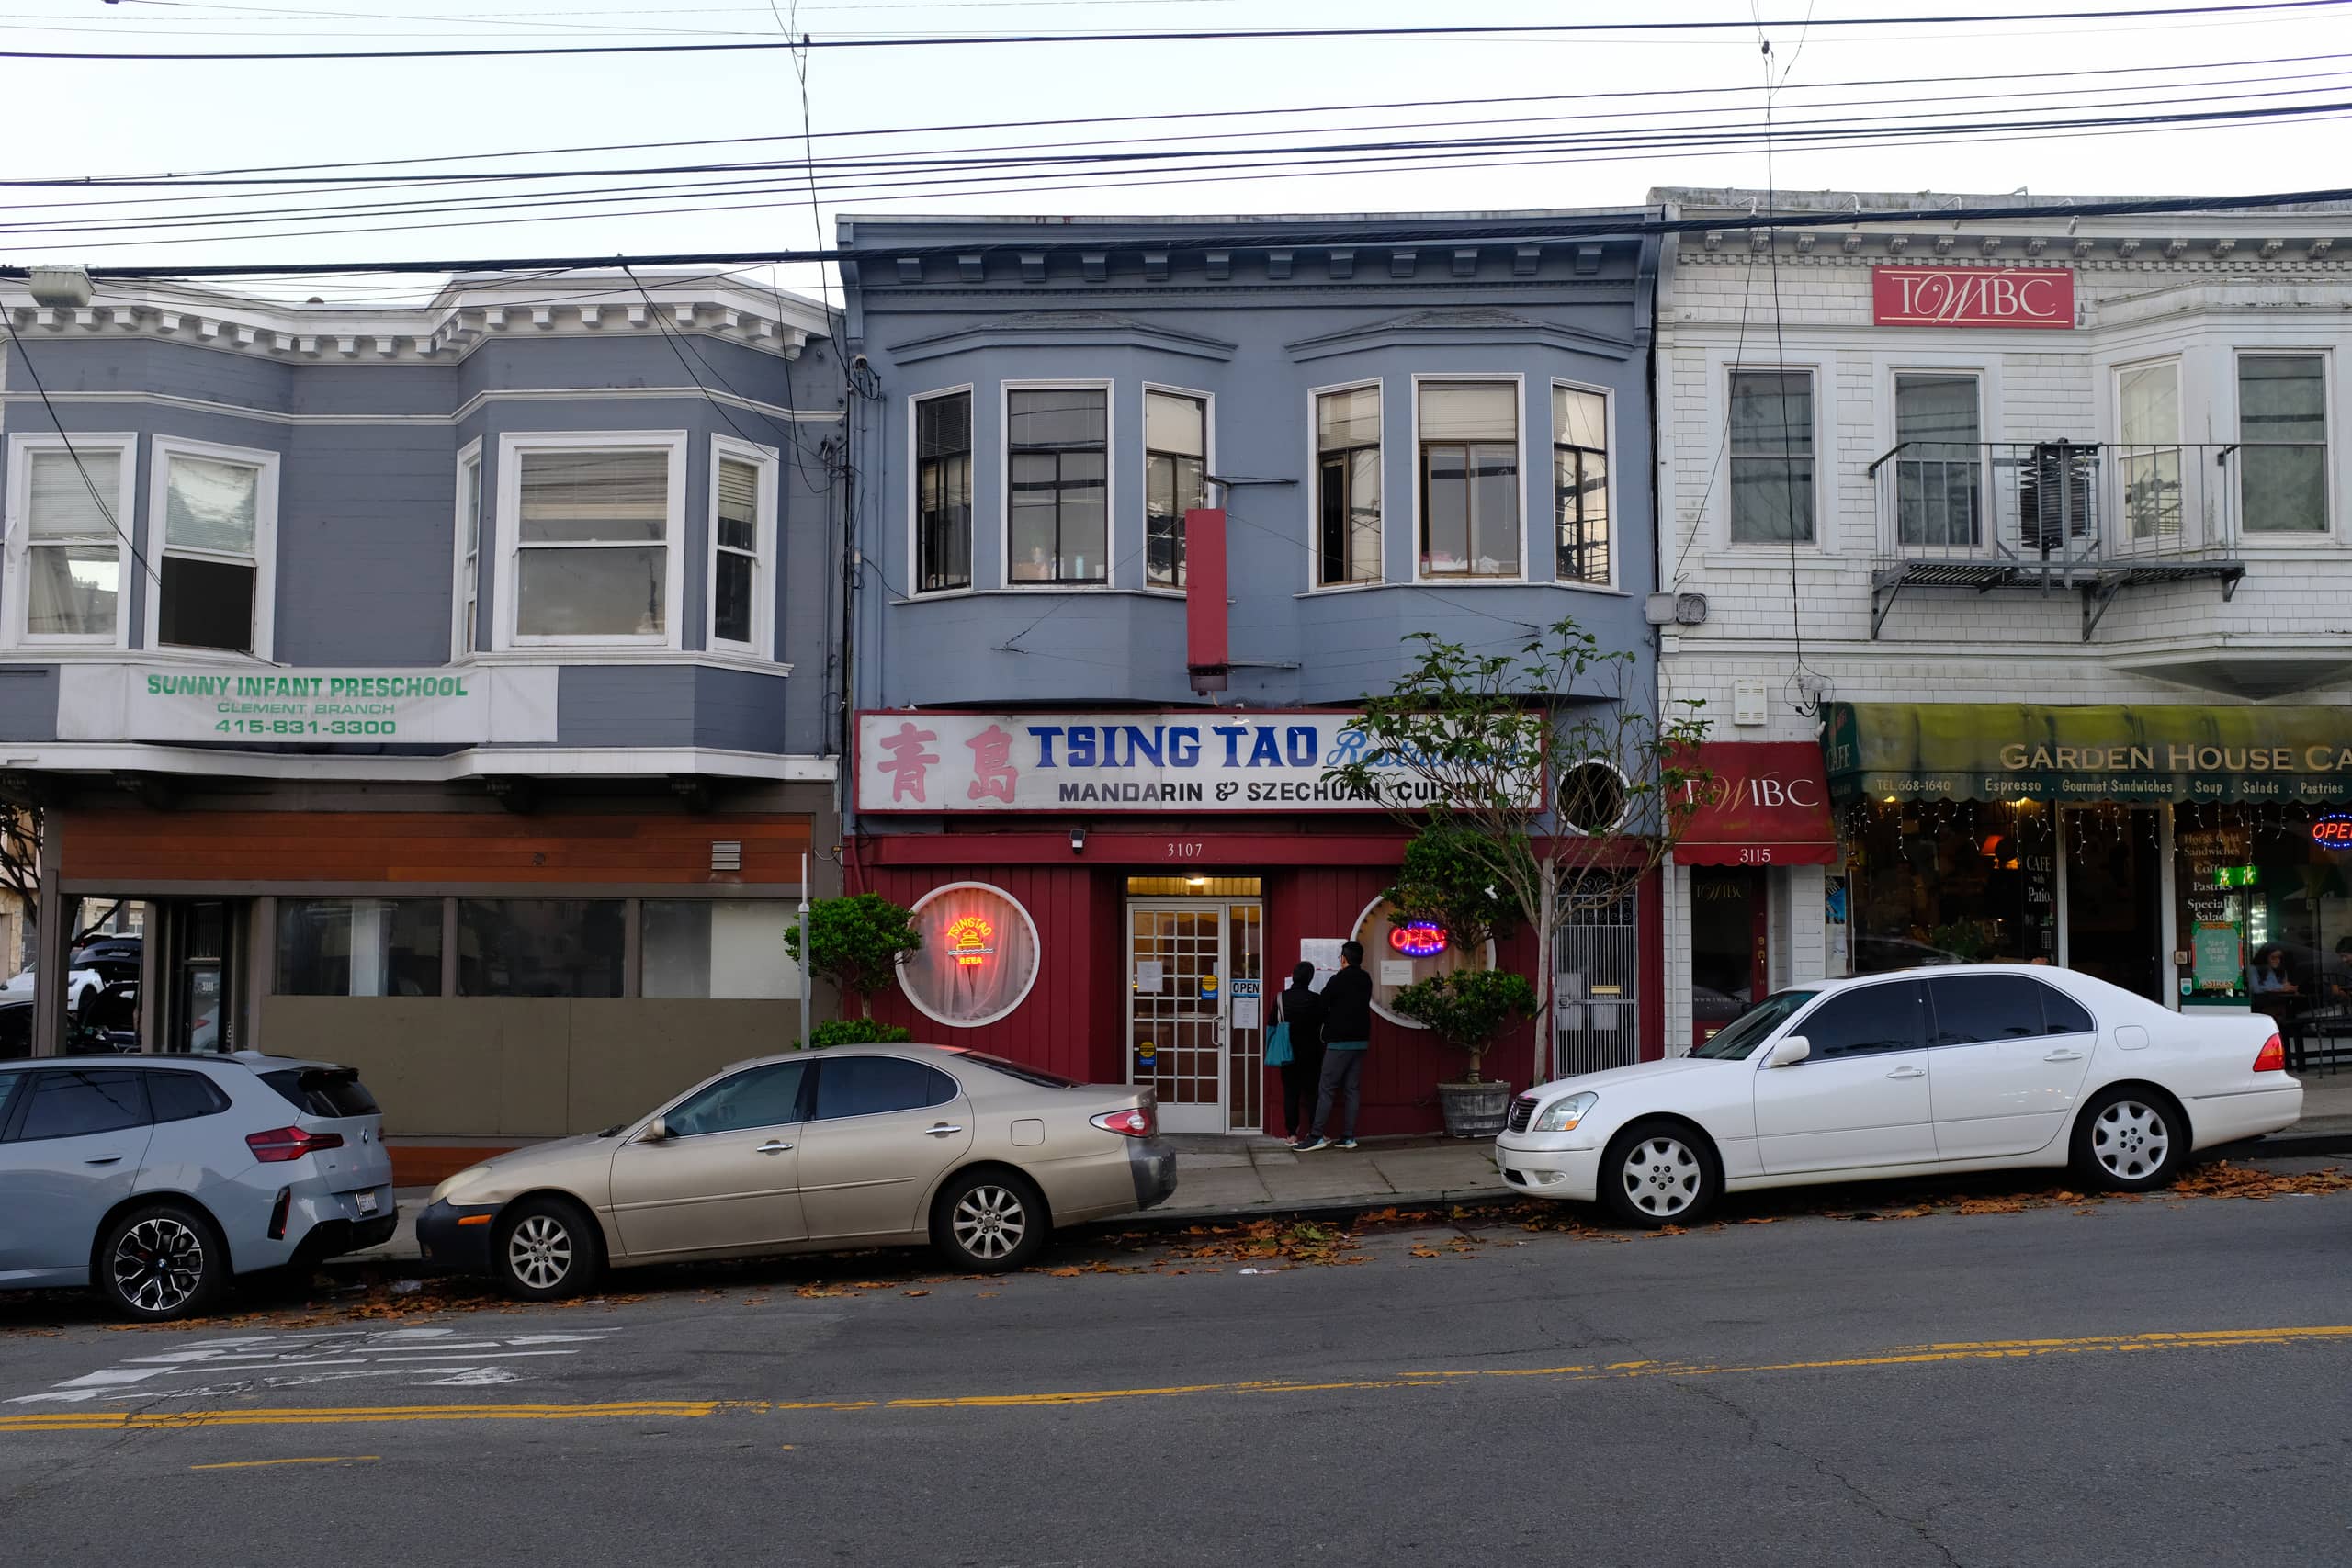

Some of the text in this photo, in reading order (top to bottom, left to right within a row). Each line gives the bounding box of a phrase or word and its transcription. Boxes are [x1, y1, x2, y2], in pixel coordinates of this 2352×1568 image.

[147, 674, 469, 698] SUNNY INFANT PRESCHOOL
[217, 702, 396, 715] CLEMENT BRANCH
[214, 719, 397, 735] 415-831-3300
[1026, 726, 1202, 768] TSING
[1212, 726, 1318, 768] TAO
[877, 722, 1019, 804] 青島
[1999, 743, 2154, 770] GARDEN
[2168, 743, 2294, 771] HOUSE
[1059, 783, 1202, 802] MANDARIN
[1216, 782, 1239, 802] &
[1247, 782, 1380, 802] SZECHUAN
[1984, 778, 2344, 797] Espresso Gourmet Sandwiches Soup Salads Pastries
[2312, 823, 2352, 839] OPE
[1167, 843, 1204, 858] 3107
[1739, 849, 1771, 863] 3115
[2026, 855, 2051, 872] CAFE
[2194, 863, 2231, 874] Coff
[2028, 886, 2051, 903] Patio
[948, 917, 992, 940] TSINGTAO
[1392, 928, 1447, 948] OPEN
[959, 956, 983, 964] BEER
[1233, 983, 1260, 994] OPEN
